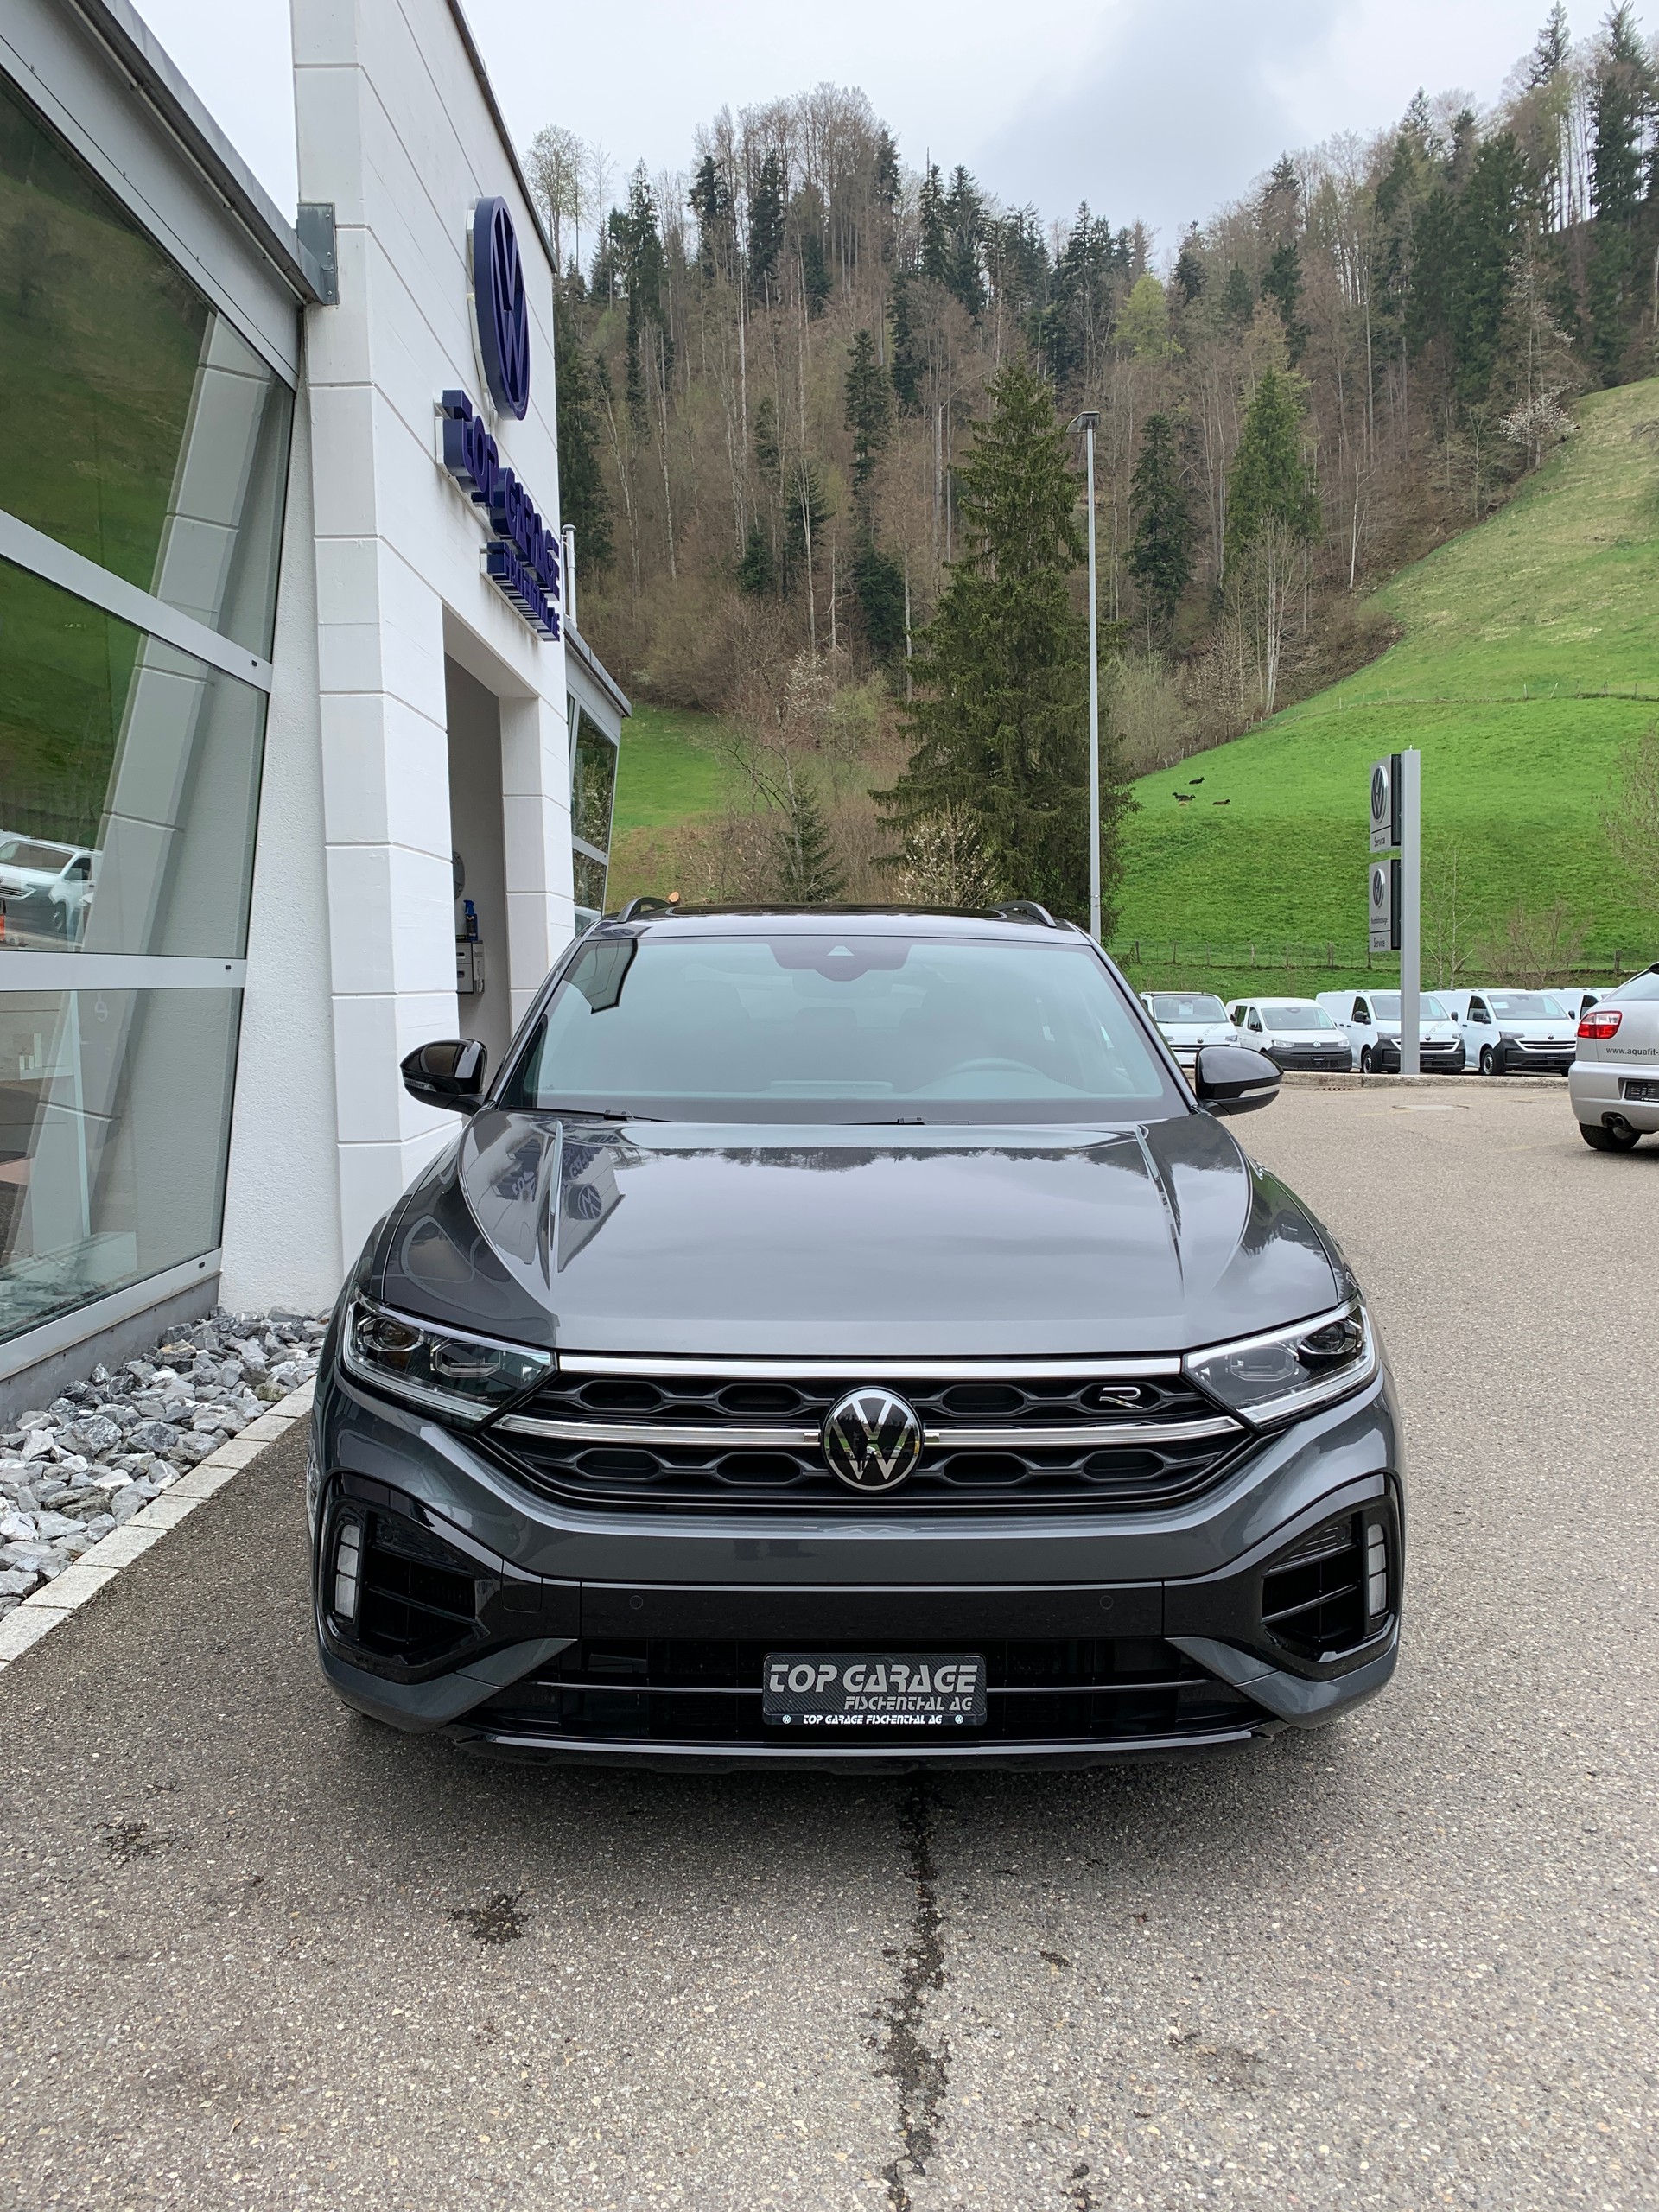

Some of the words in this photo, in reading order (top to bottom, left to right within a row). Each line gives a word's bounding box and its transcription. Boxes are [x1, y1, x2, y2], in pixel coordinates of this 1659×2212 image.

[442, 389, 499, 508] TOP
[490, 467, 560, 601] GARAGE
[1374, 836, 1385, 847] Service
[1373, 937, 1385, 948] Service
[1605, 1047, 1659, 1057] www.aquafit-
[769, 1664, 837, 1693] TOP
[842, 1664, 978, 1693] GARAGE
[844, 1696, 944, 1710] FISCHENTHAL
[949, 1697, 973, 1710] AG
[803, 1715, 823, 1725] TOP
[825, 1715, 863, 1724] GARAGE
[866, 1715, 925, 1725] FISCHENTHAL
[928, 1715, 943, 1724] AG
